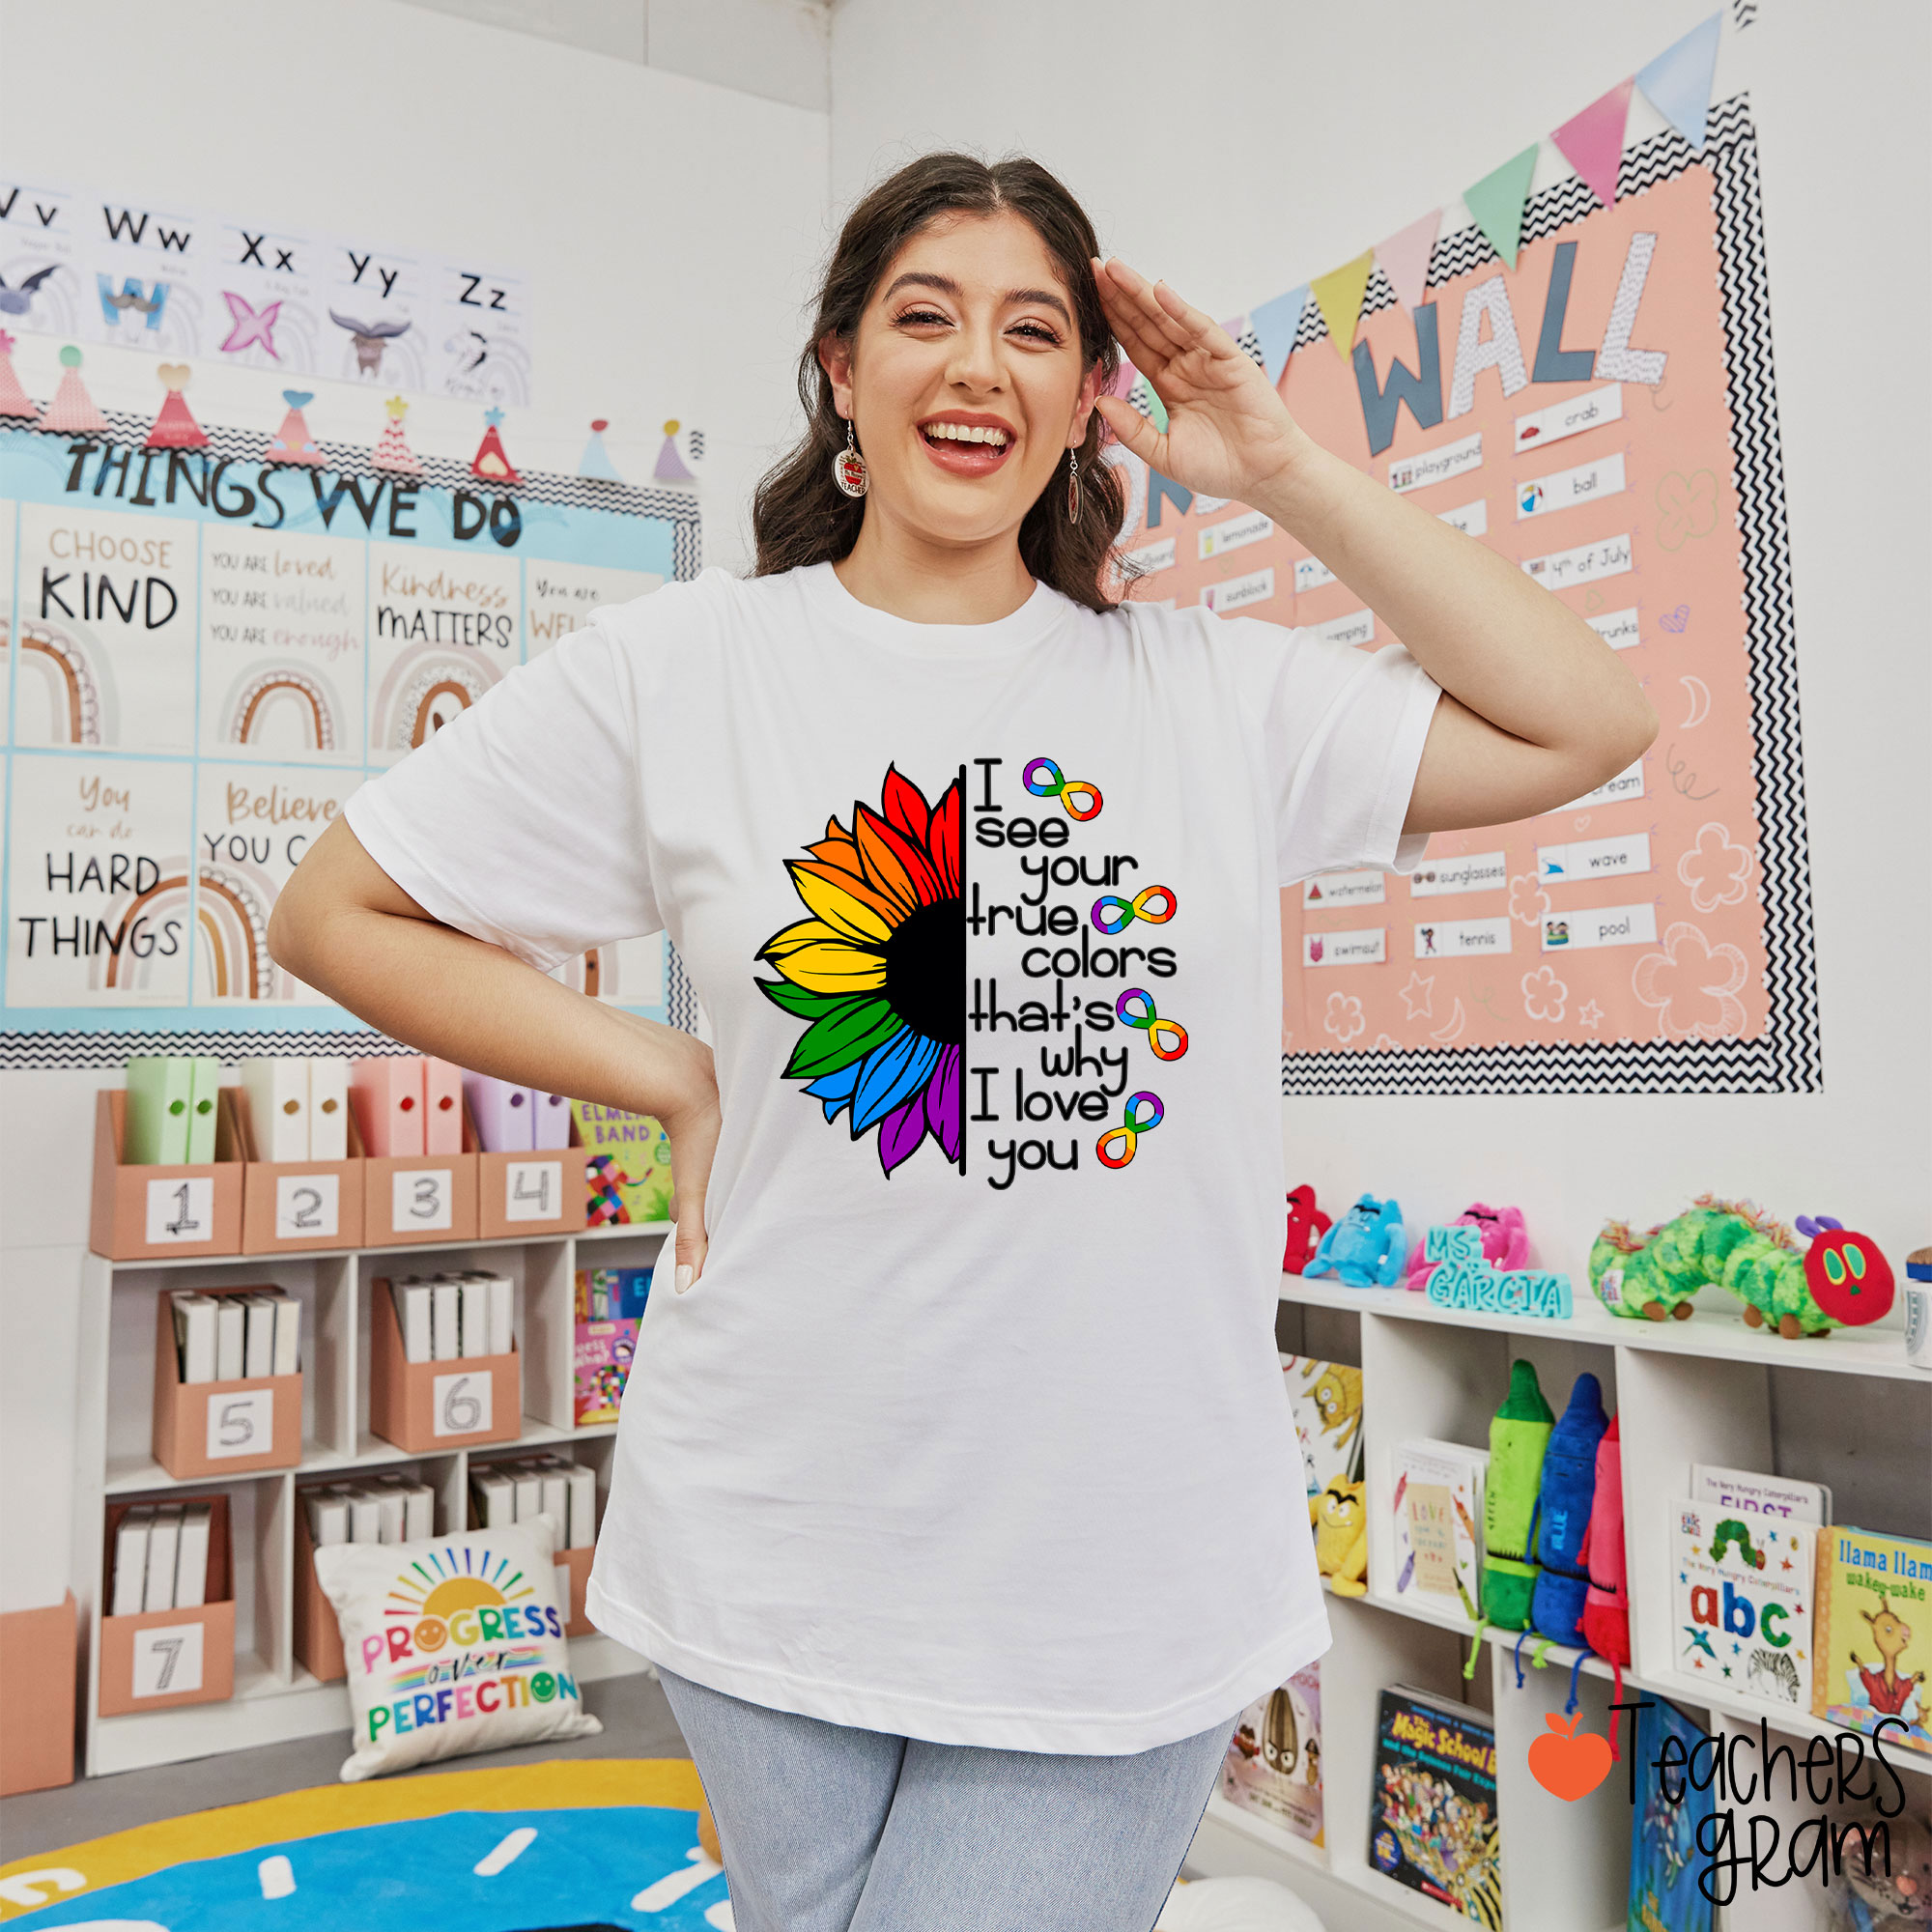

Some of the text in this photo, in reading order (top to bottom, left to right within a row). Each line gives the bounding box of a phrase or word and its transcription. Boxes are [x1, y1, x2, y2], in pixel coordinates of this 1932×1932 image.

[103, 206, 149, 243] W
[241, 231, 265, 267] X
[349, 250, 397, 298] Y y
[460, 271, 481, 306] Z
[1351, 231, 1669, 458] WALL
[1565, 401, 1599, 426] crab
[1415, 436, 1482, 479] playground
[66, 443, 523, 548] THINGS WE DO
[1573, 472, 1598, 495] ball
[49, 528, 173, 570] CHOOSE
[1222, 515, 1268, 544] lemonade
[212, 550, 335, 580] YOU ARE loved
[1577, 552, 1595, 573] of
[1600, 545, 1632, 568] July
[41, 566, 178, 630] KIND
[211, 588, 239, 606] YOU
[242, 590, 267, 609] ARE
[382, 562, 509, 609] Kindness
[210, 624, 239, 641] YOU
[242, 626, 266, 644] ARE
[79, 776, 130, 811] You
[226, 781, 338, 825] Believe
[974, 757, 1003, 812] I
[67, 820, 133, 839] can do
[204, 833, 270, 865] YOU
[975, 816, 1069, 848] see
[46, 852, 160, 895] HARD
[1020, 855, 1139, 906] your
[1439, 865, 1506, 885] sunglasses
[1589, 854, 1628, 868] wave
[966, 881, 1079, 936] true
[1600, 917, 1632, 941] pool
[19, 916, 182, 958] THINGS
[1021, 923, 1178, 979] colors
[1459, 932, 1496, 947] tennis
[968, 978, 1116, 1033] that's
[1040, 1023, 1128, 1097] why
[970, 1066, 1109, 1122] I love
[595, 1124, 651, 1144] BAND
[987, 1138, 1079, 1190] you
[166, 1182, 200, 1235] 1
[292, 1187, 323, 1228] 2
[410, 1177, 440, 1219] 3
[513, 1170, 549, 1211] 4
[1428, 1227, 1474, 1263] MS
[1428, 1267, 1564, 1317] GARCIA
[218, 1400, 255, 1447] 5
[443, 1377, 481, 1431] 6
[1839, 1539, 1888, 1573] llama
[1690, 1580, 1793, 1648] abc
[361, 1605, 562, 1675] PROGRESS
[151, 1637, 185, 1690] 7
[427, 1648, 510, 1685] over
[368, 1671, 579, 1743] PERFECTION
[1392, 1711, 1436, 1749] Magic
[1436, 1727, 1488, 1772] School
